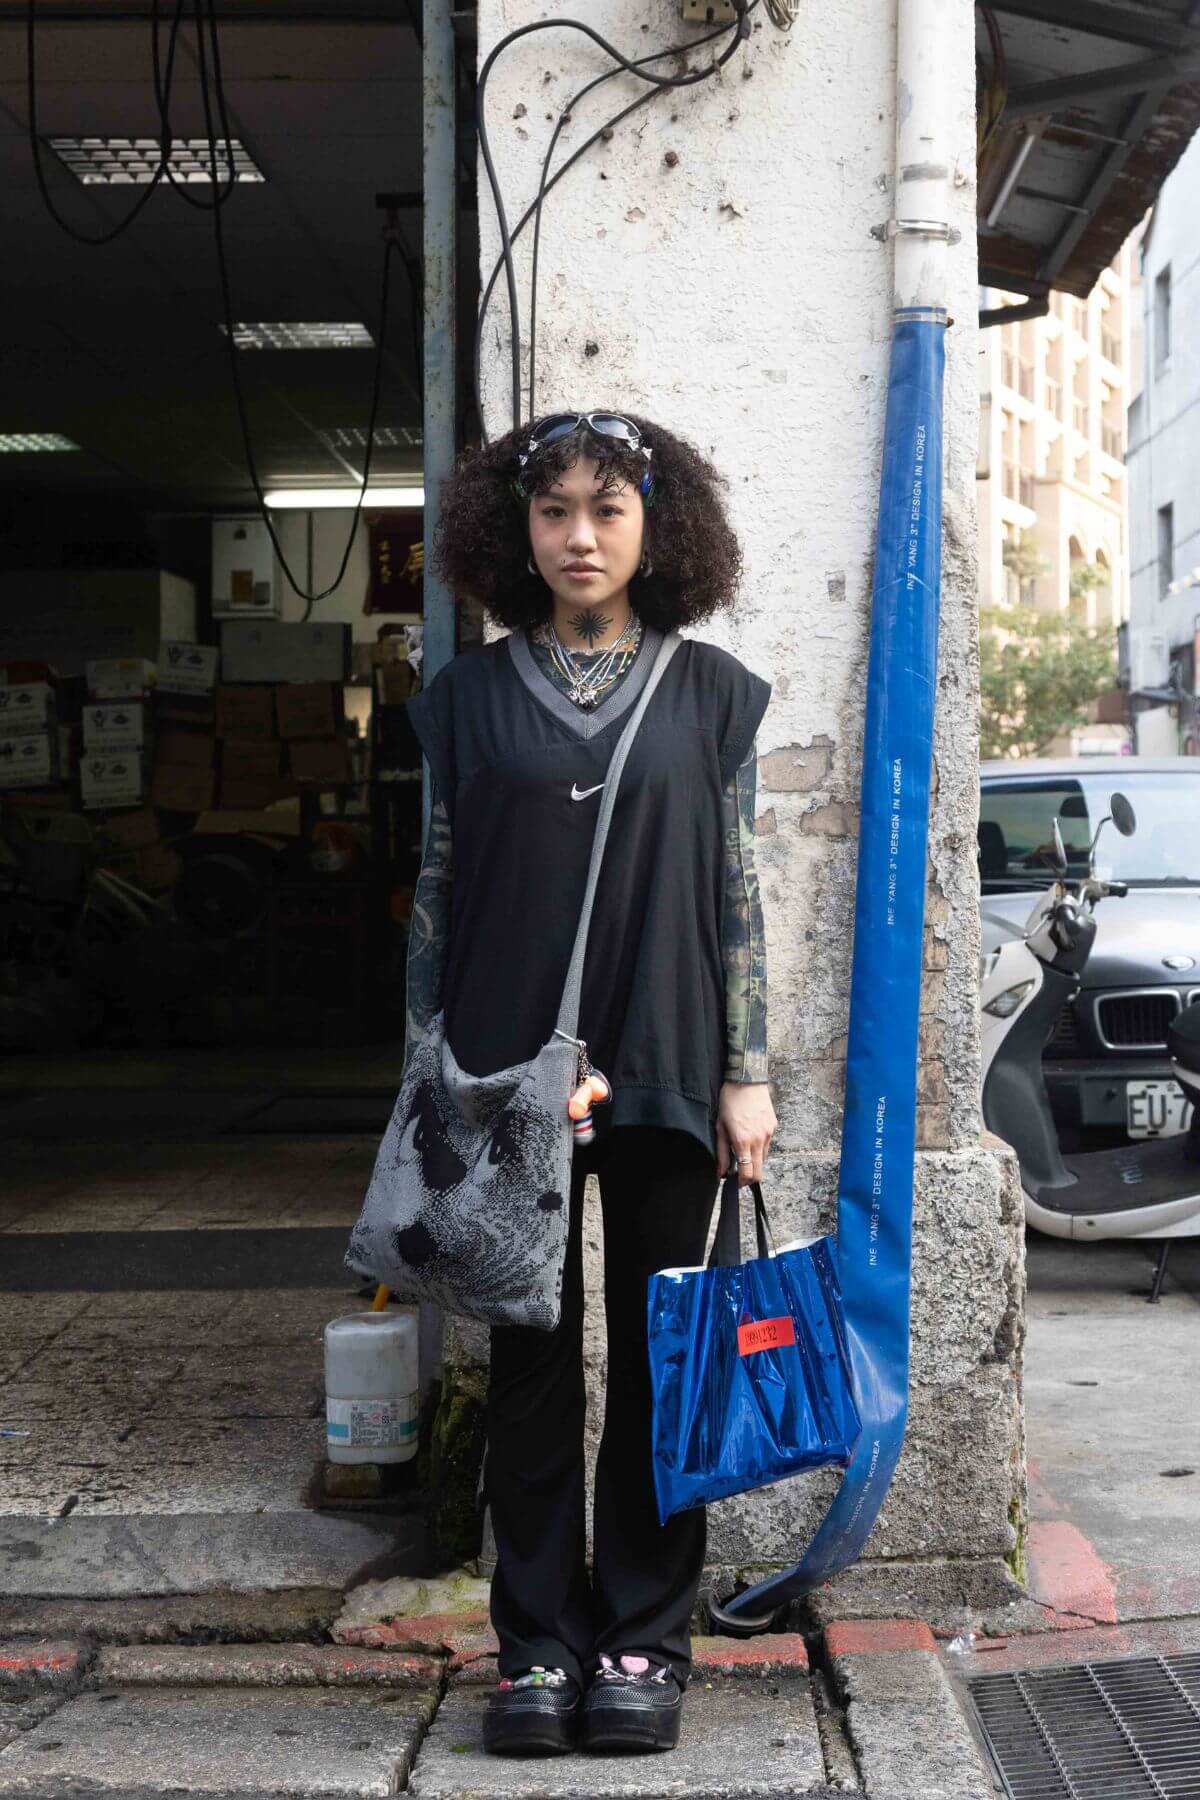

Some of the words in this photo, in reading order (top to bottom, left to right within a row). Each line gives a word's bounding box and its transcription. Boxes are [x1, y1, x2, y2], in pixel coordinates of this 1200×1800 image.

[915, 424, 926, 462] KOREA
[914, 464, 924, 477] IN
[911, 480, 922, 521] DESIGN
[908, 539, 918, 568] YANG
[893, 758, 903, 794] KOREA
[892, 799, 901, 810] IN
[890, 815, 900, 855] DESIGN
[888, 875, 897, 906] YANG
[887, 907, 896, 925] INE
[876, 1096, 887, 1133] KOREA
[875, 1138, 883, 1149] IN
[872, 1153, 883, 1195] DESIGN
[869, 1214, 879, 1243] YANG
[869, 1247, 878, 1266] INE
[845, 1496, 865, 1535] DESIGN
[862, 1481, 872, 1493] IN
[868, 1439, 881, 1478] KOREA
